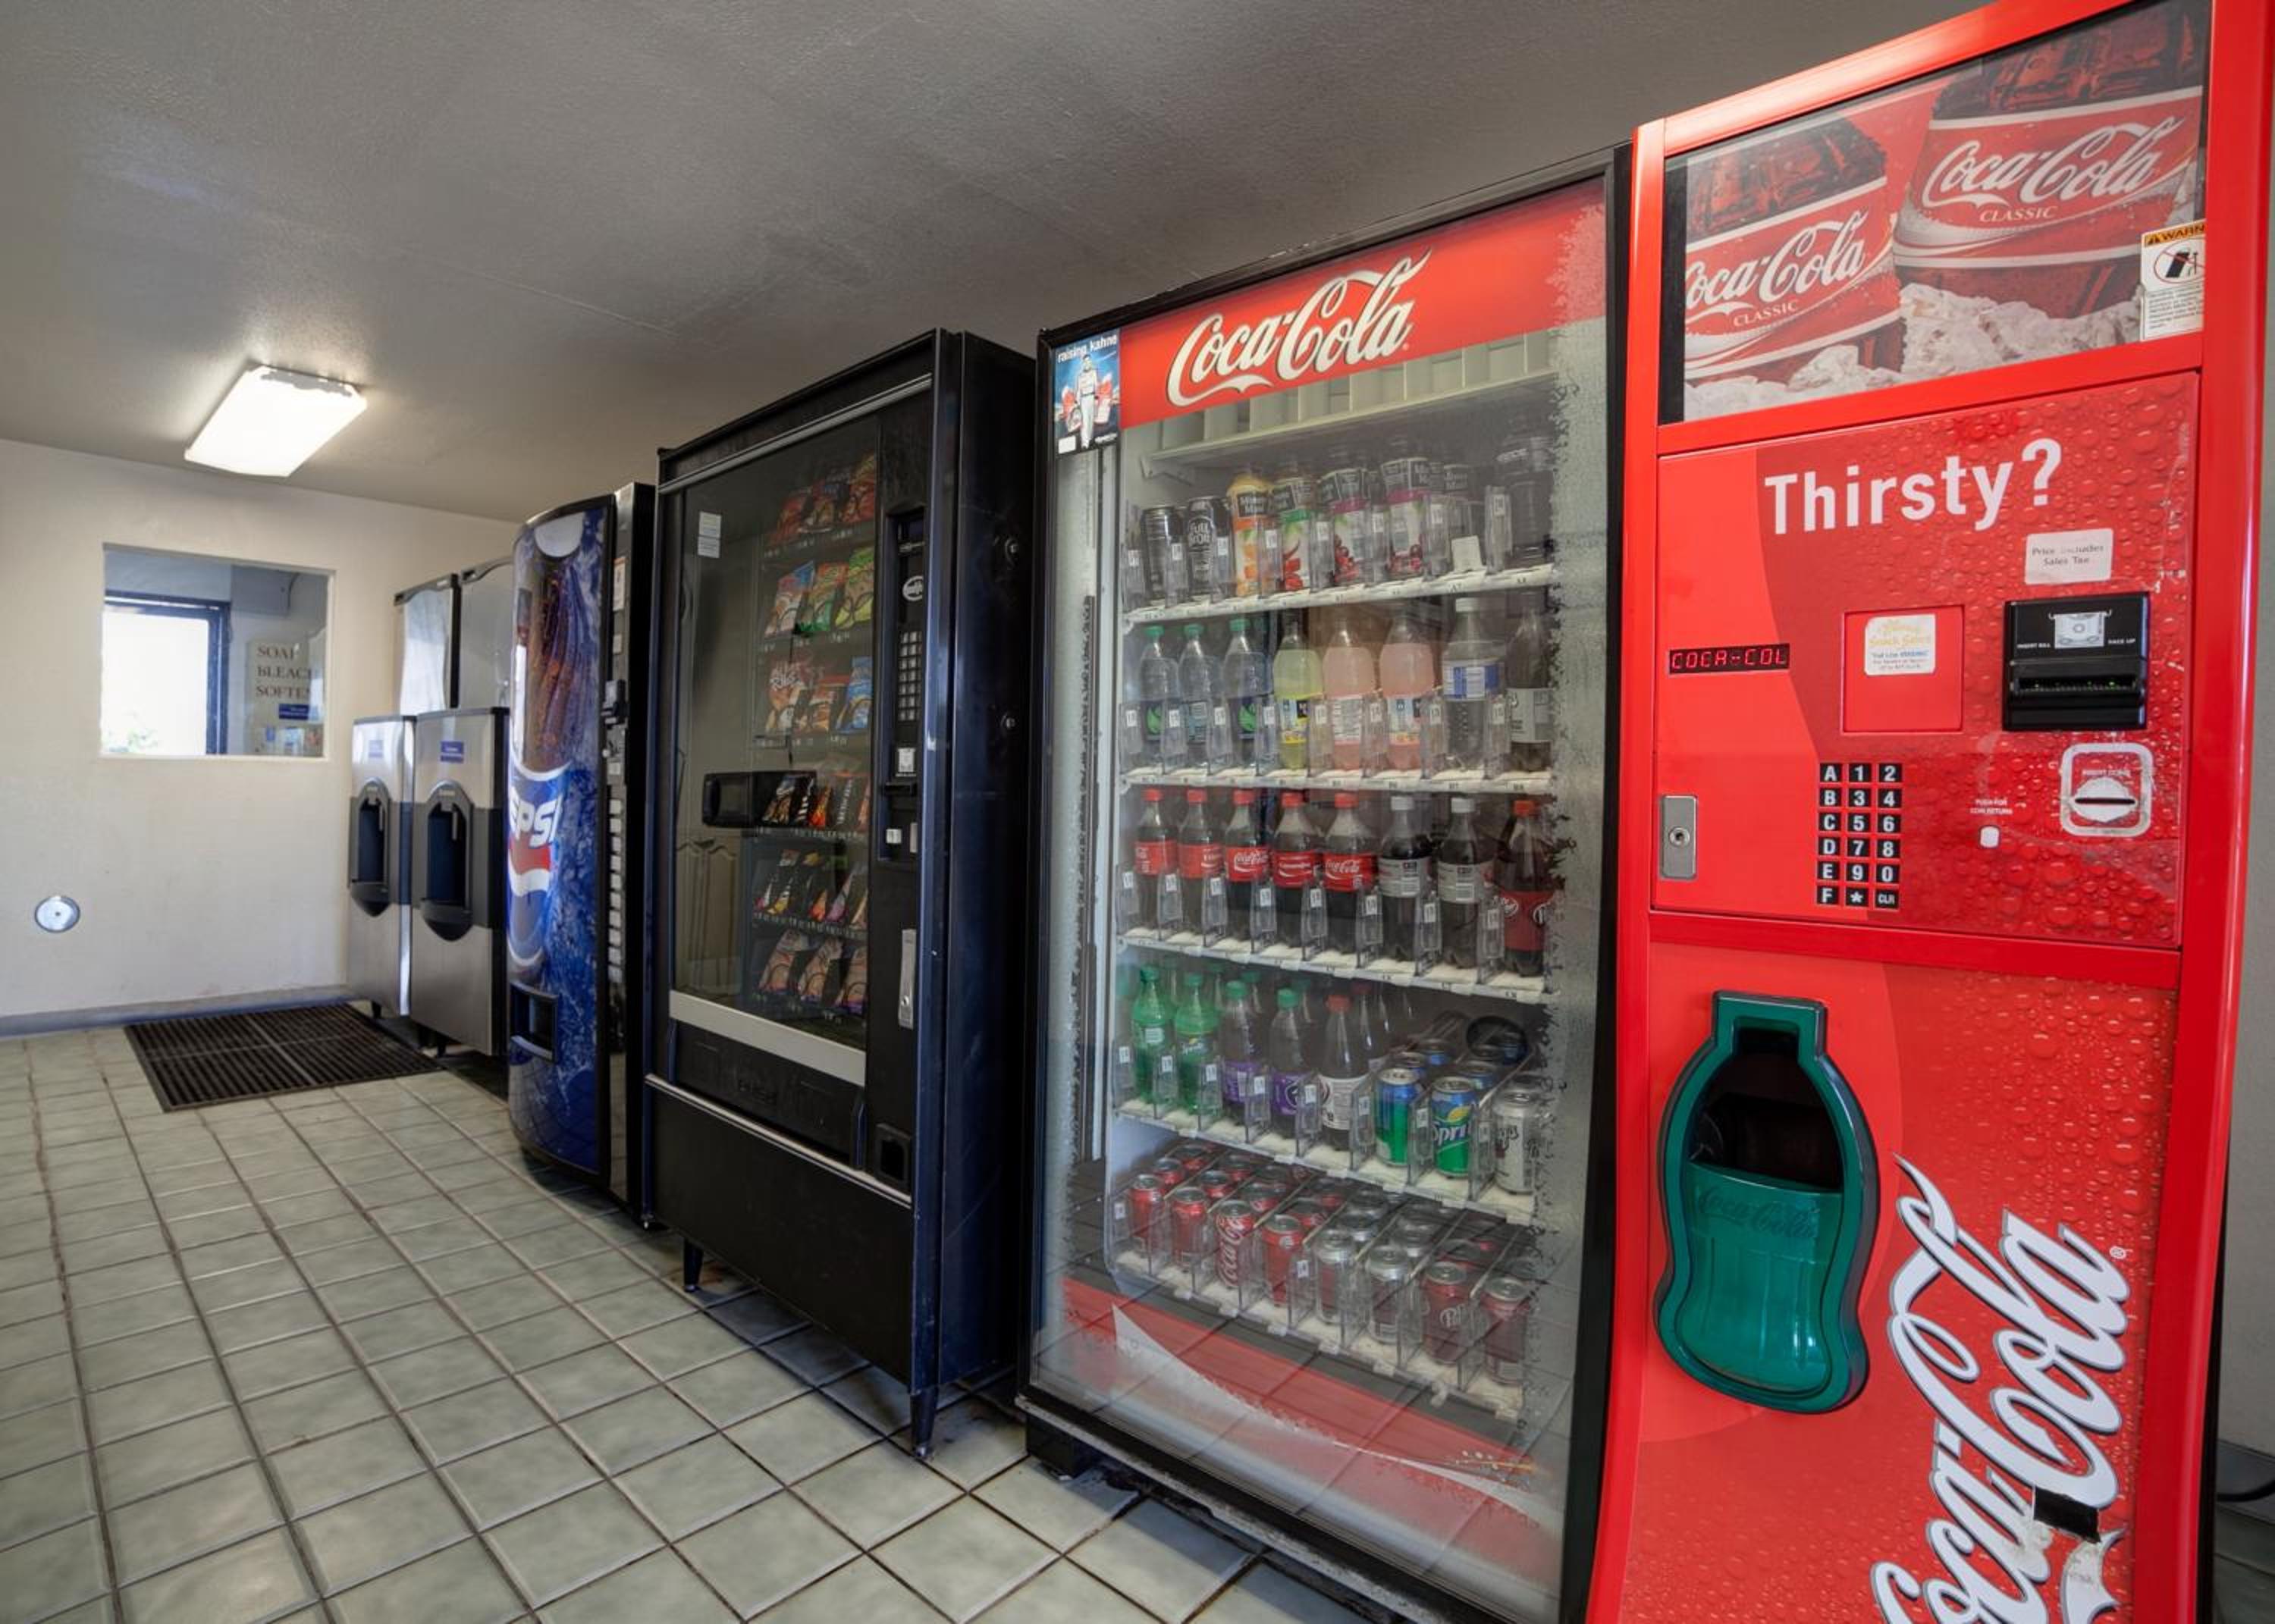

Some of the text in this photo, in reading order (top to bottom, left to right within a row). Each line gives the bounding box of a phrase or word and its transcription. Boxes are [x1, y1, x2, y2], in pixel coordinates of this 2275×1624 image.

[1922, 116, 2185, 208] Coca-Cola
[1979, 205, 2058, 223] CLASSIC
[1733, 300, 1801, 328] CLASSIC
[1166, 247, 1432, 407] Coca-Cola
[1764, 437, 2063, 535] Thirsty?
[2032, 547, 2055, 556] Price
[2044, 556, 2089, 566] Sales Tax
[1671, 648, 1786, 669] COCA-COL
[1824, 765, 1895, 782] A 1 2
[1824, 790, 1895, 807] B 3 4
[509, 788, 563, 848] EPSI
[1823, 814, 1894, 832] C 5 6
[1823, 839, 1894, 857] D 7 8
[1822, 864, 1894, 882] E 9 0
[1822, 888, 1833, 903] F
[1870, 1151, 2130, 1624] ca-Cola
